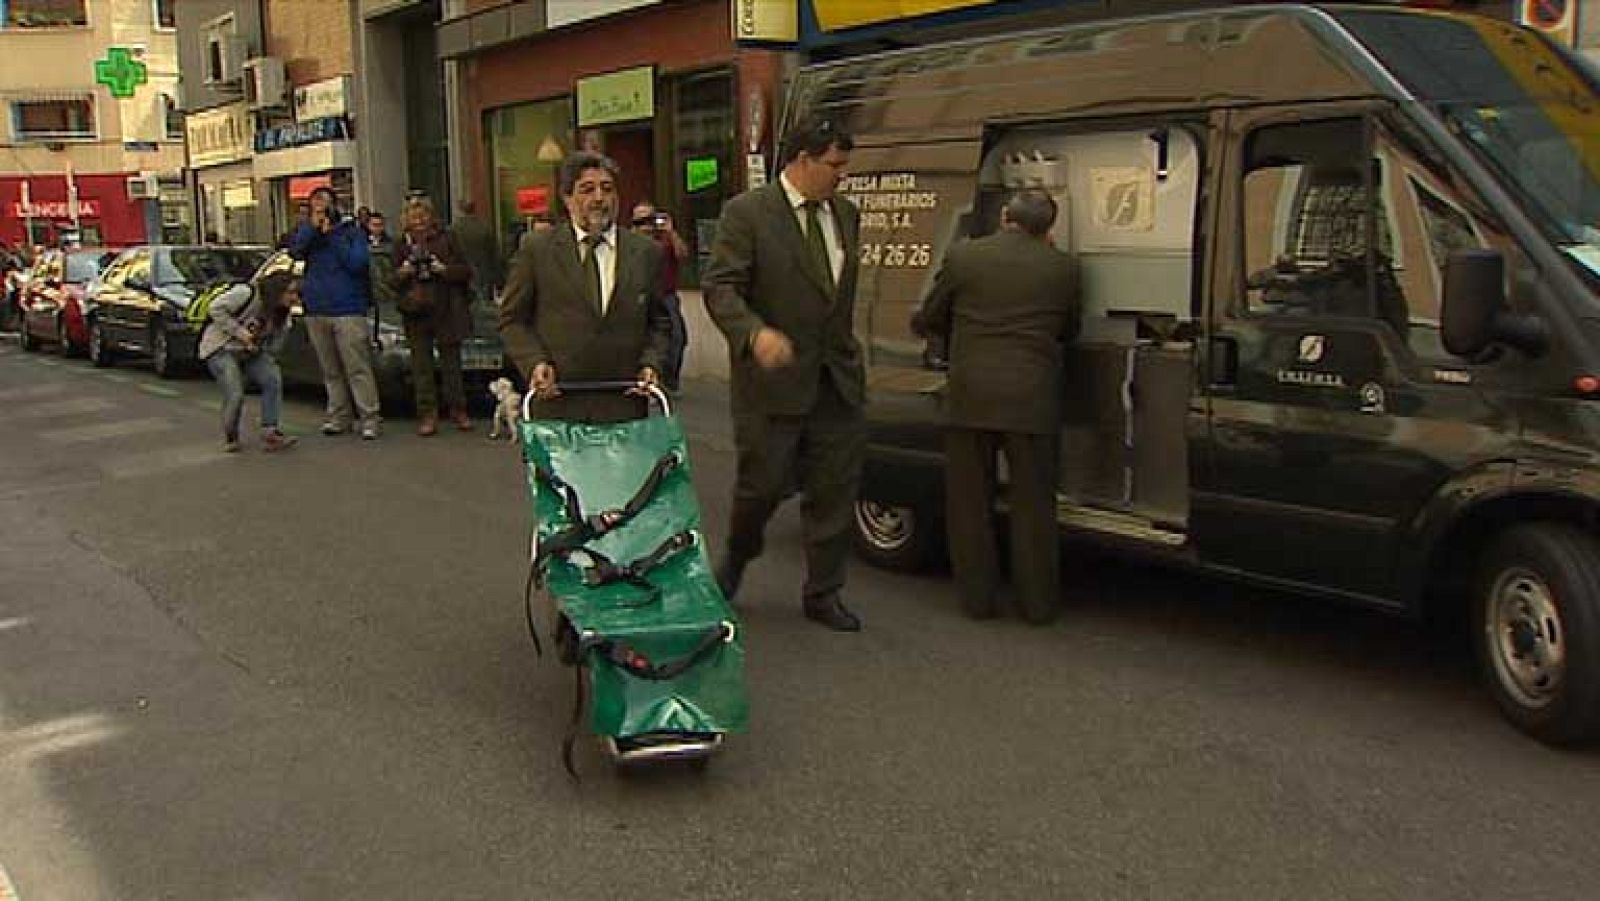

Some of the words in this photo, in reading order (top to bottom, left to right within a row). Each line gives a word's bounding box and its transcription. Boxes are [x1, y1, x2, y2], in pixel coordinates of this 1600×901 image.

[881, 175, 916, 191] MIXTA
[16, 201, 94, 217] LENCEIA
[860, 243, 882, 264] 24
[884, 243, 905, 265] 26
[908, 243, 931, 265] 26
